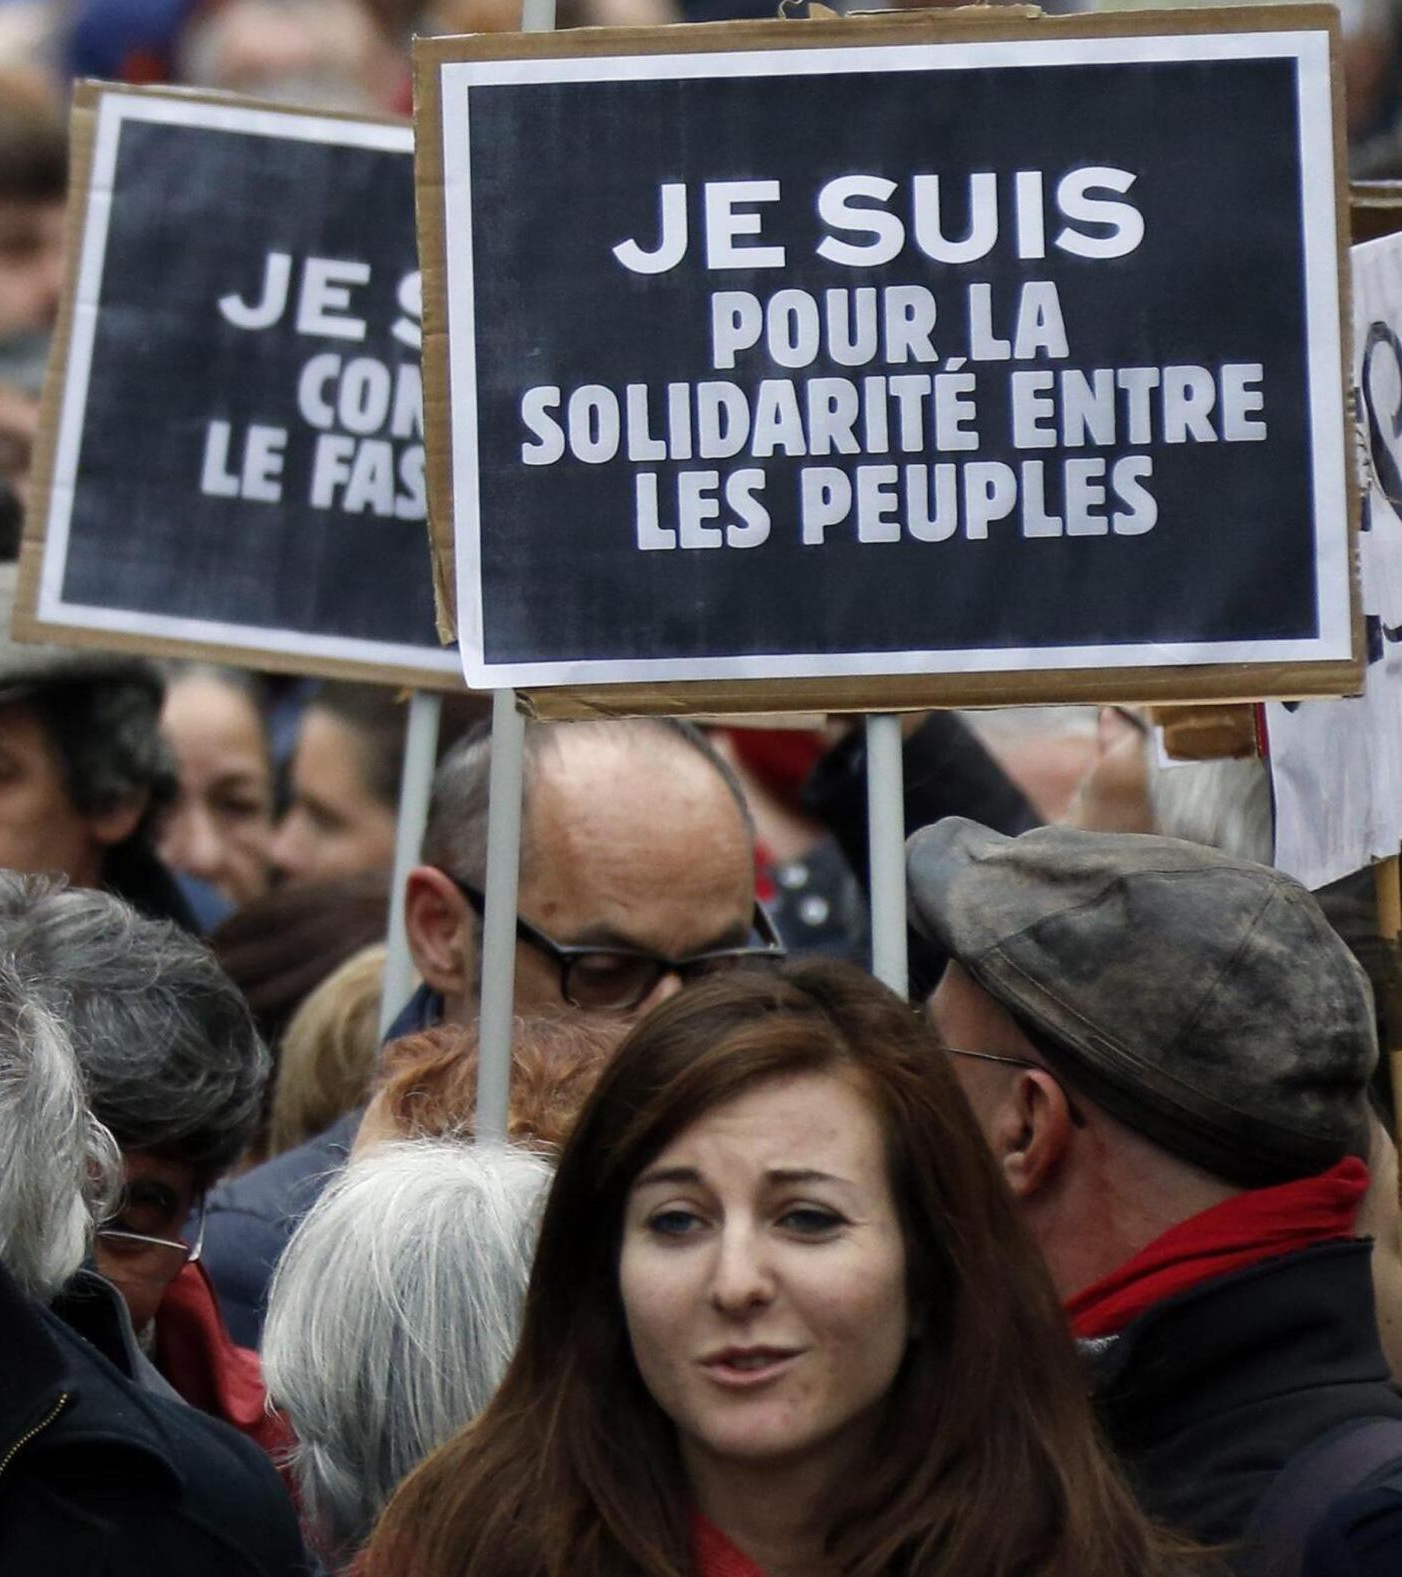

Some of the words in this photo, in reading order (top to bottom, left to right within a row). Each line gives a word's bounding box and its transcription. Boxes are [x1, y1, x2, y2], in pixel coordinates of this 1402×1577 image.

[612, 179, 786, 275] JE
[815, 166, 1145, 267] SUIS
[219, 250, 371, 342] JE
[711, 284, 939, 371] POUR
[968, 280, 1070, 361] LA
[521, 356, 980, 466] SOLIDARITÉ
[1010, 363, 1267, 449] ENTRE
[201, 420, 288, 503] LE
[635, 468, 771, 551] LES
[800, 455, 1158, 546] PEUPLES
